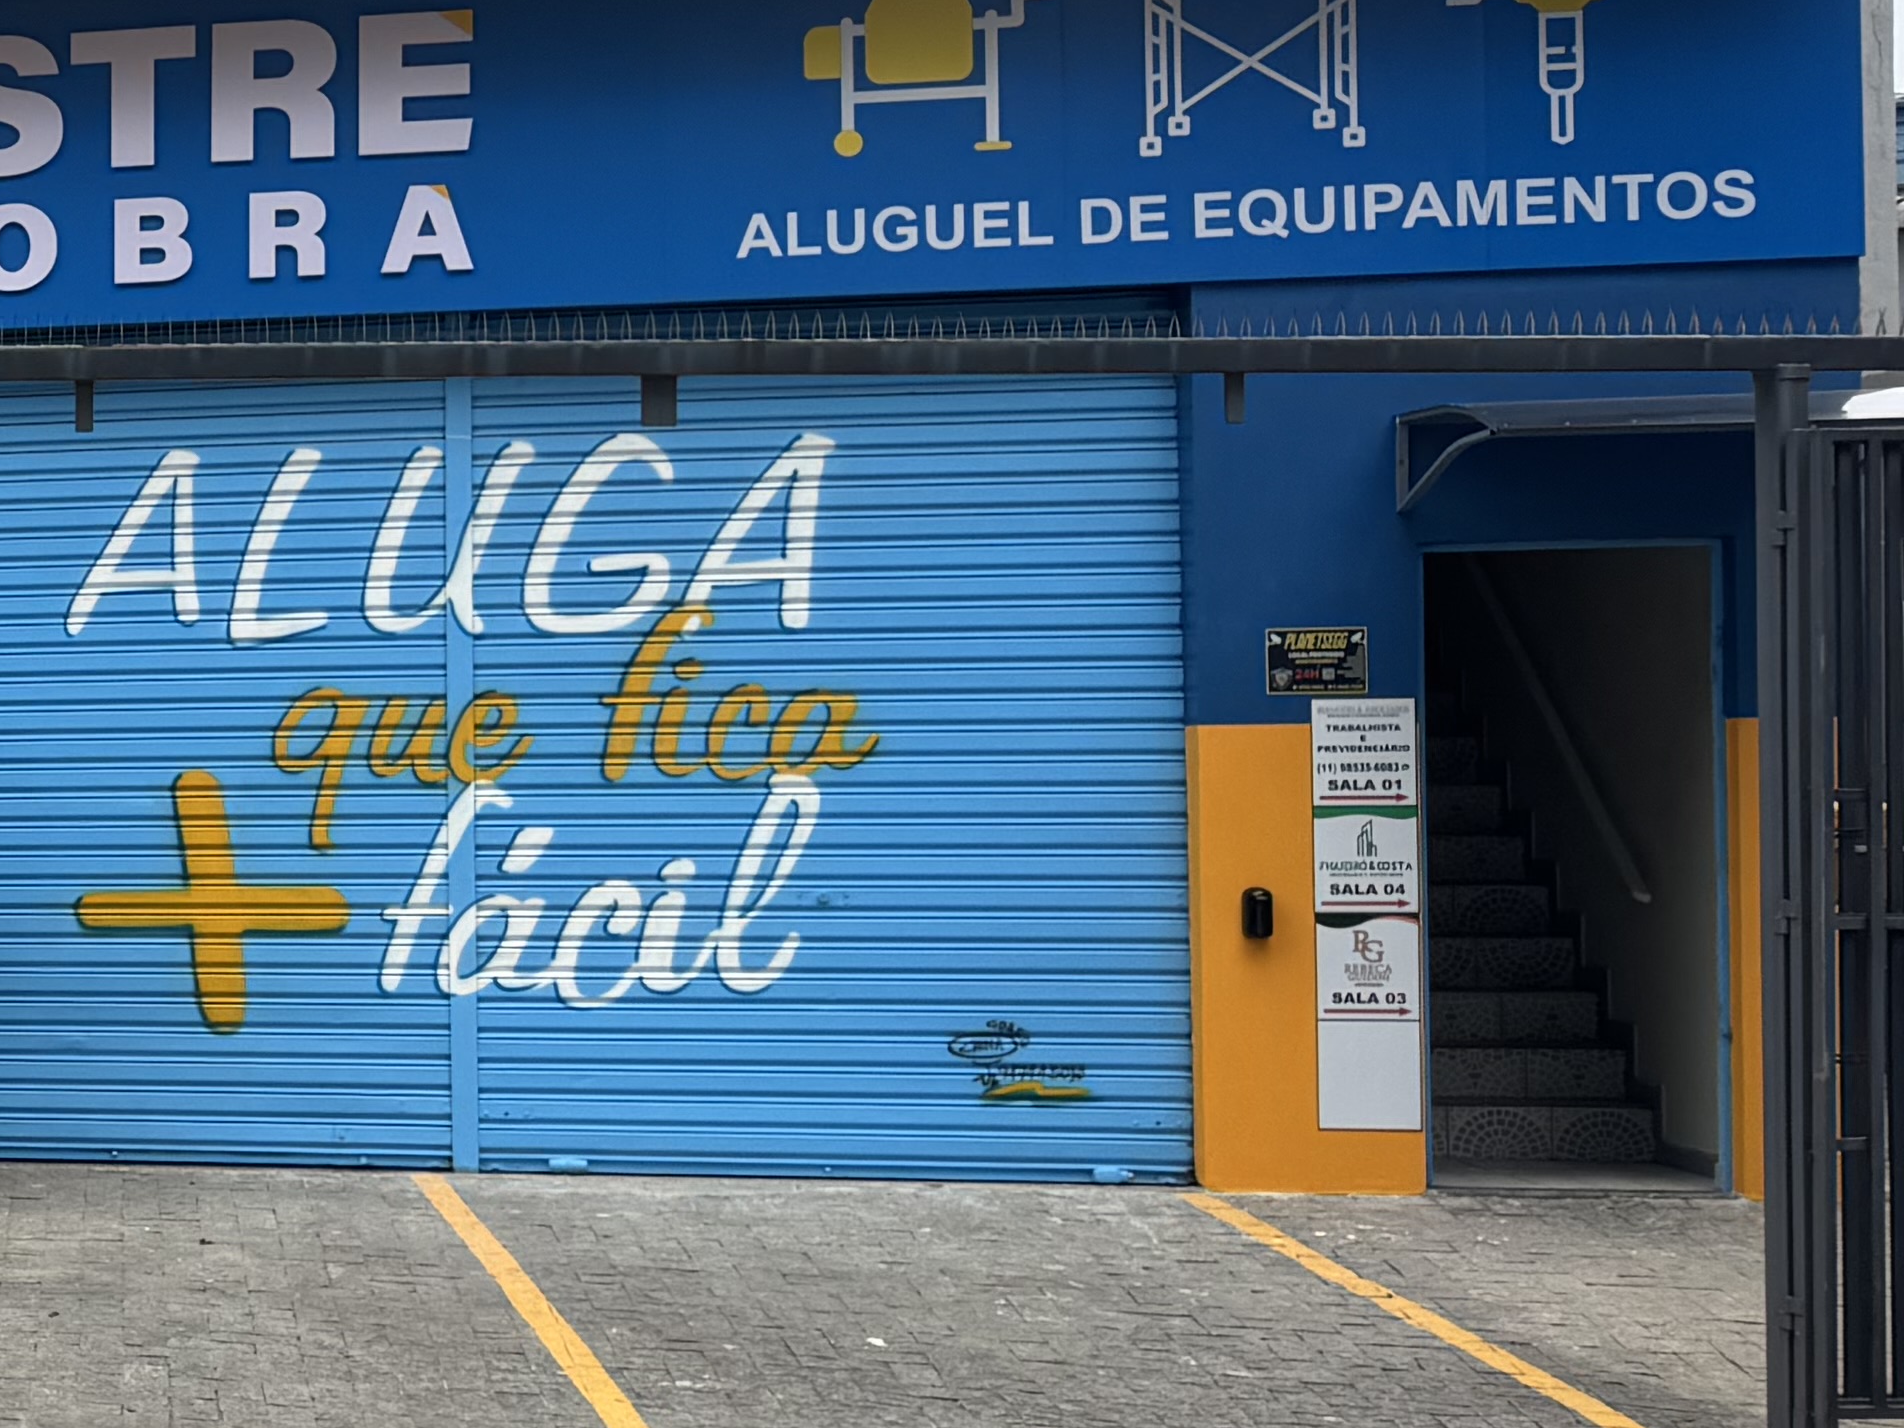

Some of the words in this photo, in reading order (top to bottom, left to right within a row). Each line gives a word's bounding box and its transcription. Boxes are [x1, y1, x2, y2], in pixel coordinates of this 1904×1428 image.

[735, 199, 1055, 259] ALUGUEL
[1081, 194, 1168, 246] DE
[1193, 168, 1758, 241] EQUIPAMENTOS
[64, 432, 837, 646] ALUGA
[272, 686, 534, 851] que
[600, 605, 880, 781] fica
[1326, 724, 1401, 732] TRABALHISTA
[1328, 779, 1376, 791] SALA
[1382, 779, 1402, 791] 01
[379, 773, 823, 1009] fácil
[1330, 884, 1378, 895] SALA
[1384, 884, 1405, 895] 04
[1332, 992, 1379, 1004] SALA
[1386, 992, 1406, 1004] 03
